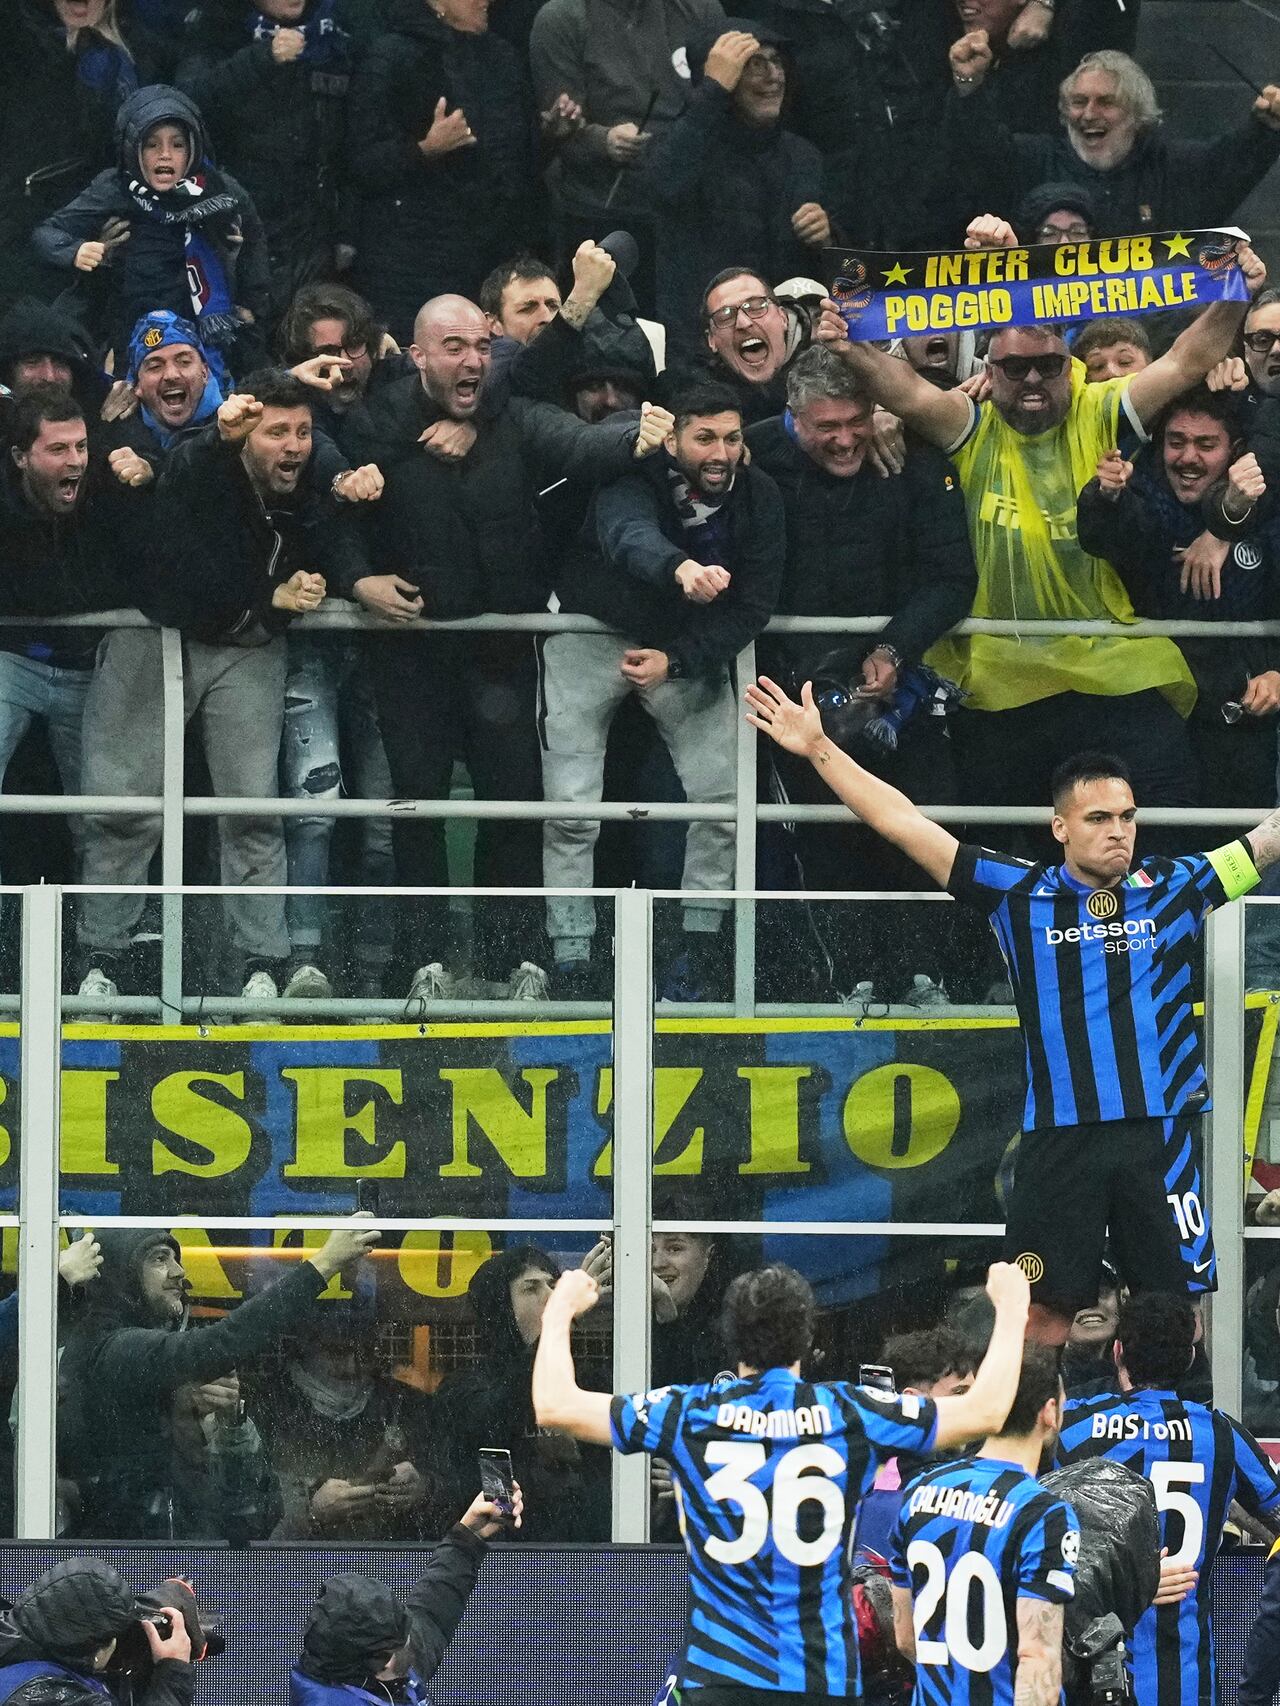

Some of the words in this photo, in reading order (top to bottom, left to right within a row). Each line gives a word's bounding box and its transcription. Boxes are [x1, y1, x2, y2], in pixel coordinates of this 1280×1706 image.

[924, 248, 1030, 288] INTER
[1054, 236, 1155, 276] CLUB
[885, 288, 1013, 333] POGGIO
[1033, 271, 1199, 319] IMPERIALE
[1045, 918, 1157, 945] betsson
[1099, 935, 1158, 956] .sport
[0, 1062, 962, 1178] ISENZIO
[1166, 1191, 1205, 1239] 10
[716, 1403, 832, 1438] DARMIAN
[703, 1440, 847, 1567] 36
[906, 1539, 1008, 1674] 20
